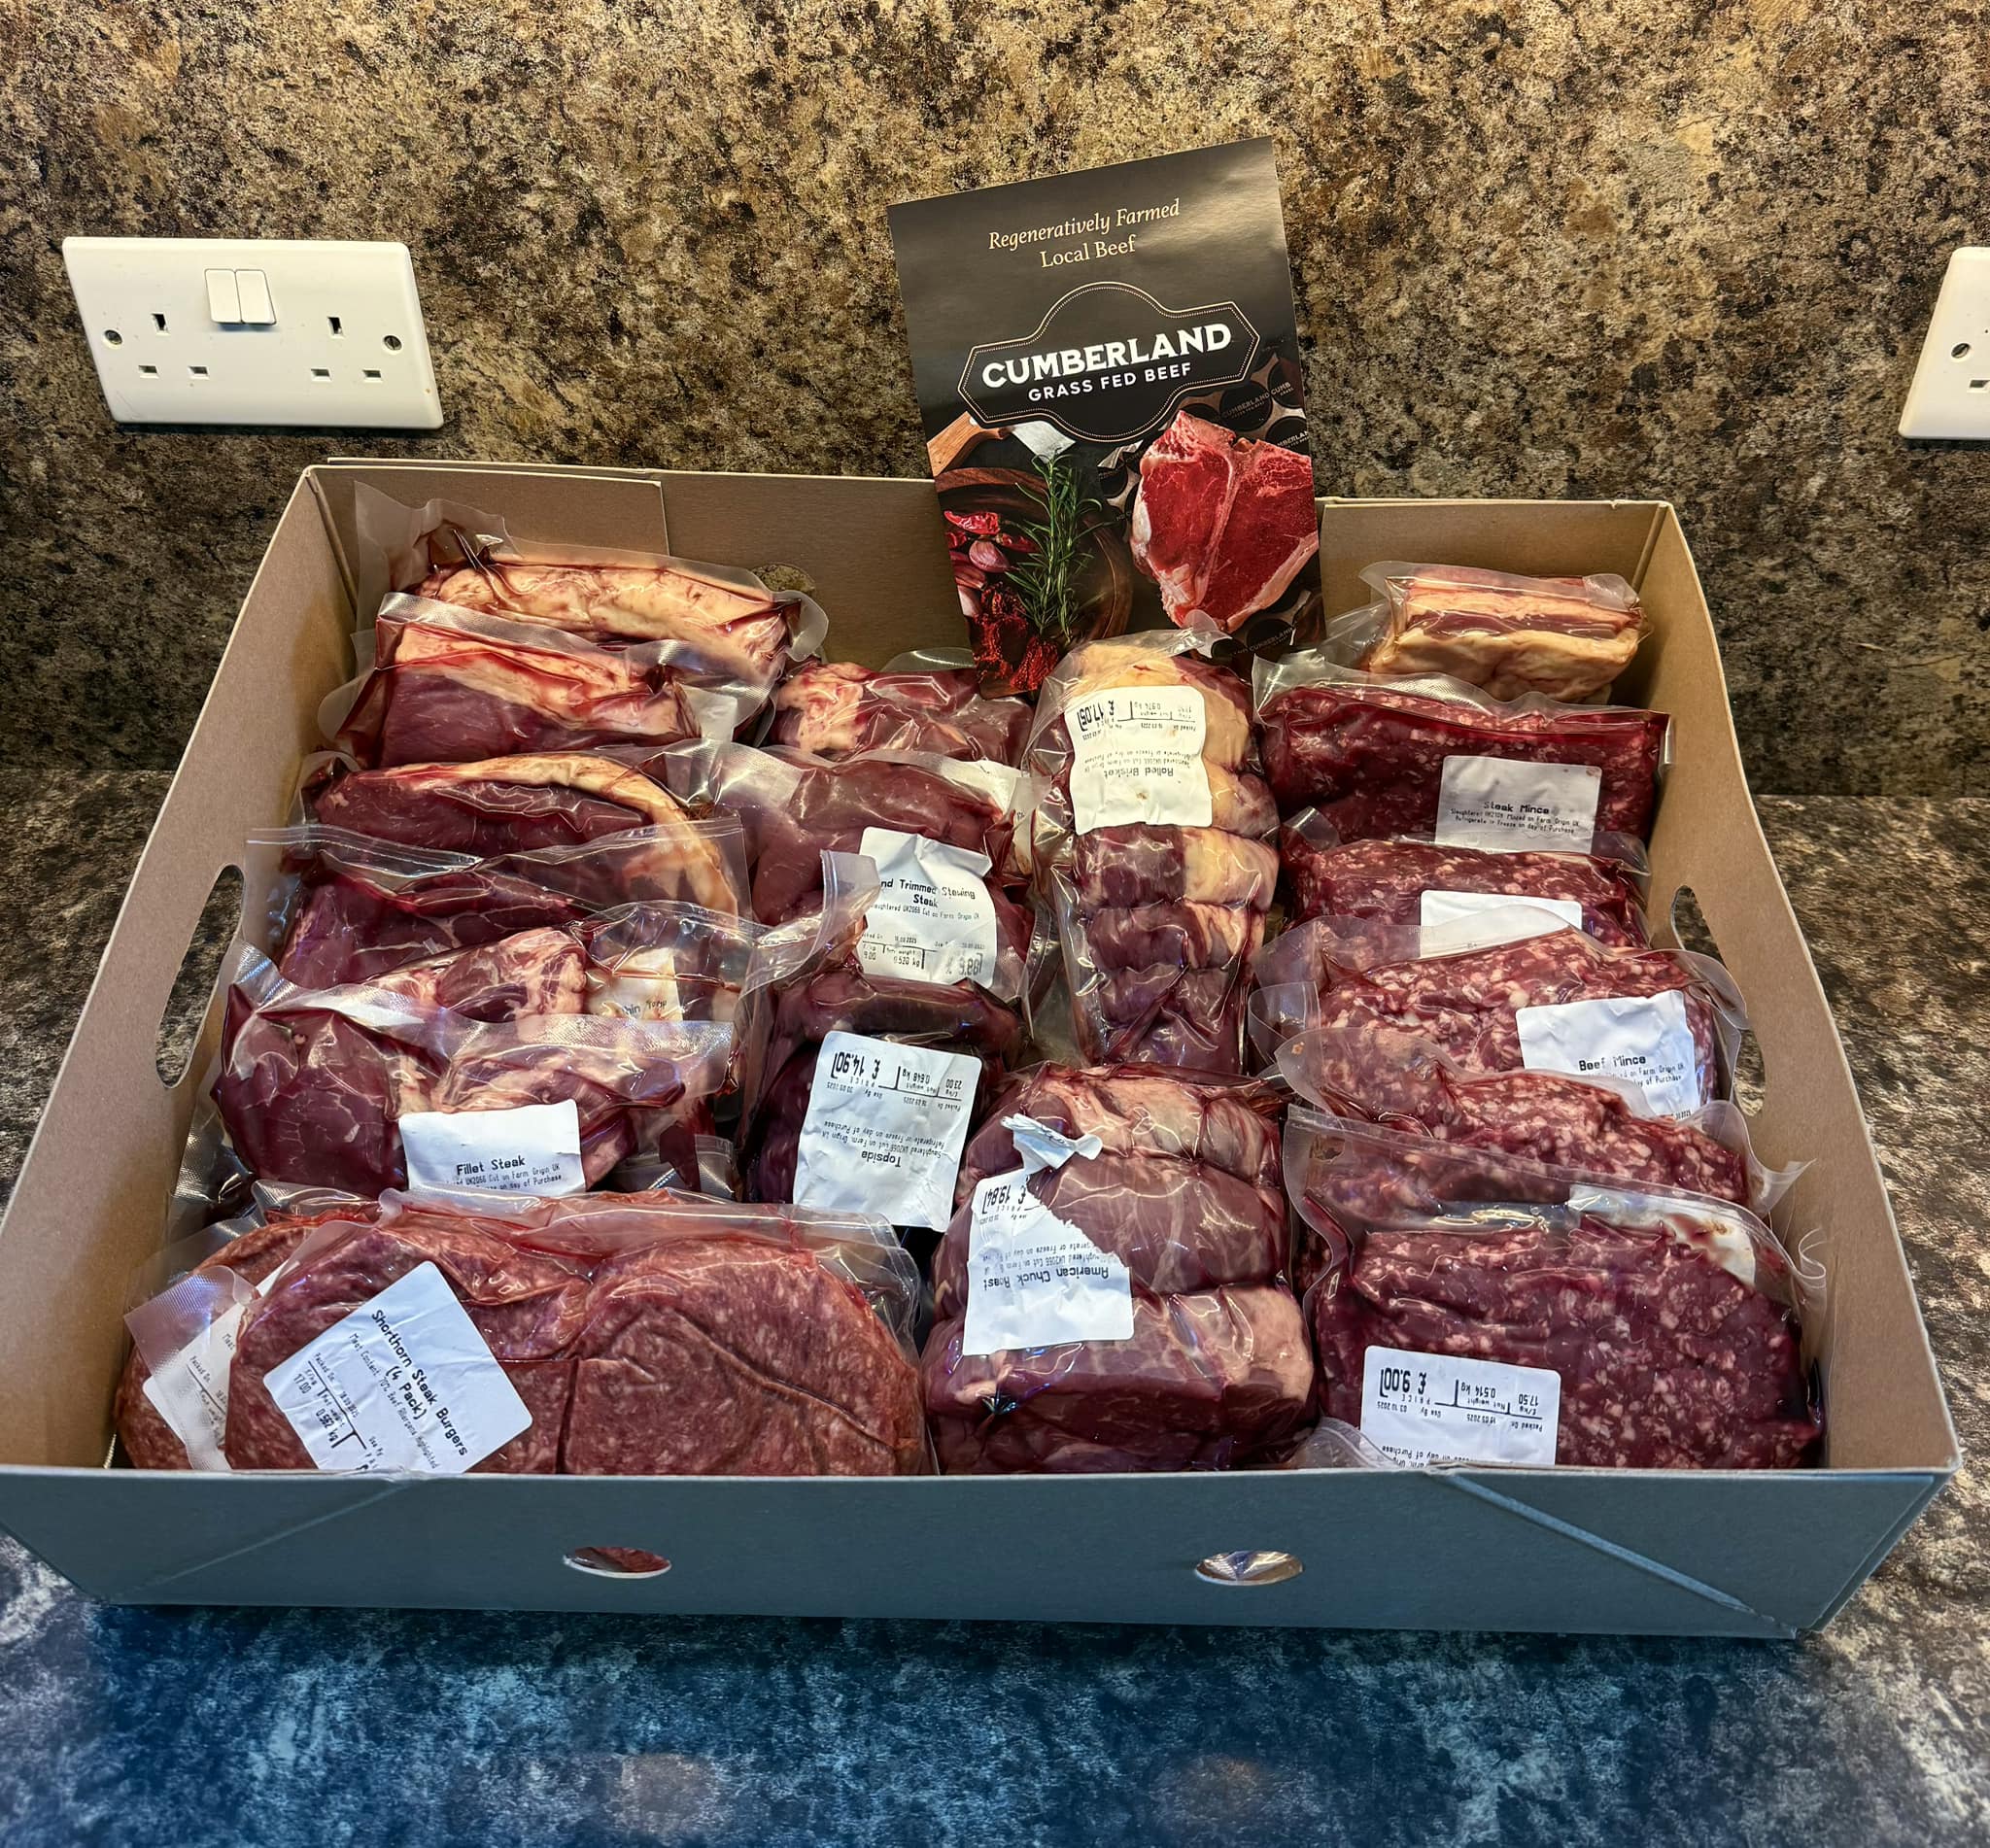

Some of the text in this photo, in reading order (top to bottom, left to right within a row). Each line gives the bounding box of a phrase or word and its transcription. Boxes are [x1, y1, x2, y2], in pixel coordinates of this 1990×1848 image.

[988, 197, 1180, 252] Regeneratively Farmed
[1041, 234, 1136, 267] Local Beef
[982, 323, 1231, 388] CUMBERLAND
[1028, 362, 1191, 401] GRASS FED BEEF
[1080, 702, 1104, 727] 17.05
[1103, 767, 1140, 779] Brisket
[1145, 768, 1174, 777] Rolled
[1484, 801, 1549, 814] Steak Mince
[900, 879, 938, 895] Trimmed
[942, 887, 976, 900] Stewing
[912, 894, 940, 907] Steak
[837, 1052, 880, 1079] £ 14.90
[1578, 1055, 1646, 1072] Beef Mince
[903, 1069, 911, 1080] kg
[824, 1120, 850, 1134] Purchase
[851, 1126, 860, 1135] of
[862, 1126, 875, 1136] day
[861, 1150, 902, 1167] Topside
[456, 1155, 526, 1176] Fillet Steak
[532, 1166, 550, 1177] Origin
[524, 1178, 531, 1187] of
[533, 1175, 562, 1185] Purchase
[988, 1184, 1026, 1207] £ 19.84
[1036, 1244, 1057, 1254] Freeze
[983, 1266, 1109, 1291] American Chuck Roast
[371, 1310, 467, 1456] Shorthorn Steak Burgers
[1384, 1367, 1427, 1395] £ 9.00
[1460, 1382, 1471, 1395] kg
[1475, 1387, 1496, 1399] 0.514
[399, 1382, 427, 1420] Pack)
[1401, 1393, 1430, 1405] PRICE
[1467, 1397, 1491, 1407] weight
[1493, 1401, 1505, 1410] Net
[1430, 1410, 1441, 1419] Use
[1523, 1421, 1543, 1432] Packed
[327, 1428, 339, 1442] kg
[1382, 1445, 1412, 1459] Purchase
[1415, 1451, 1423, 1459] of
